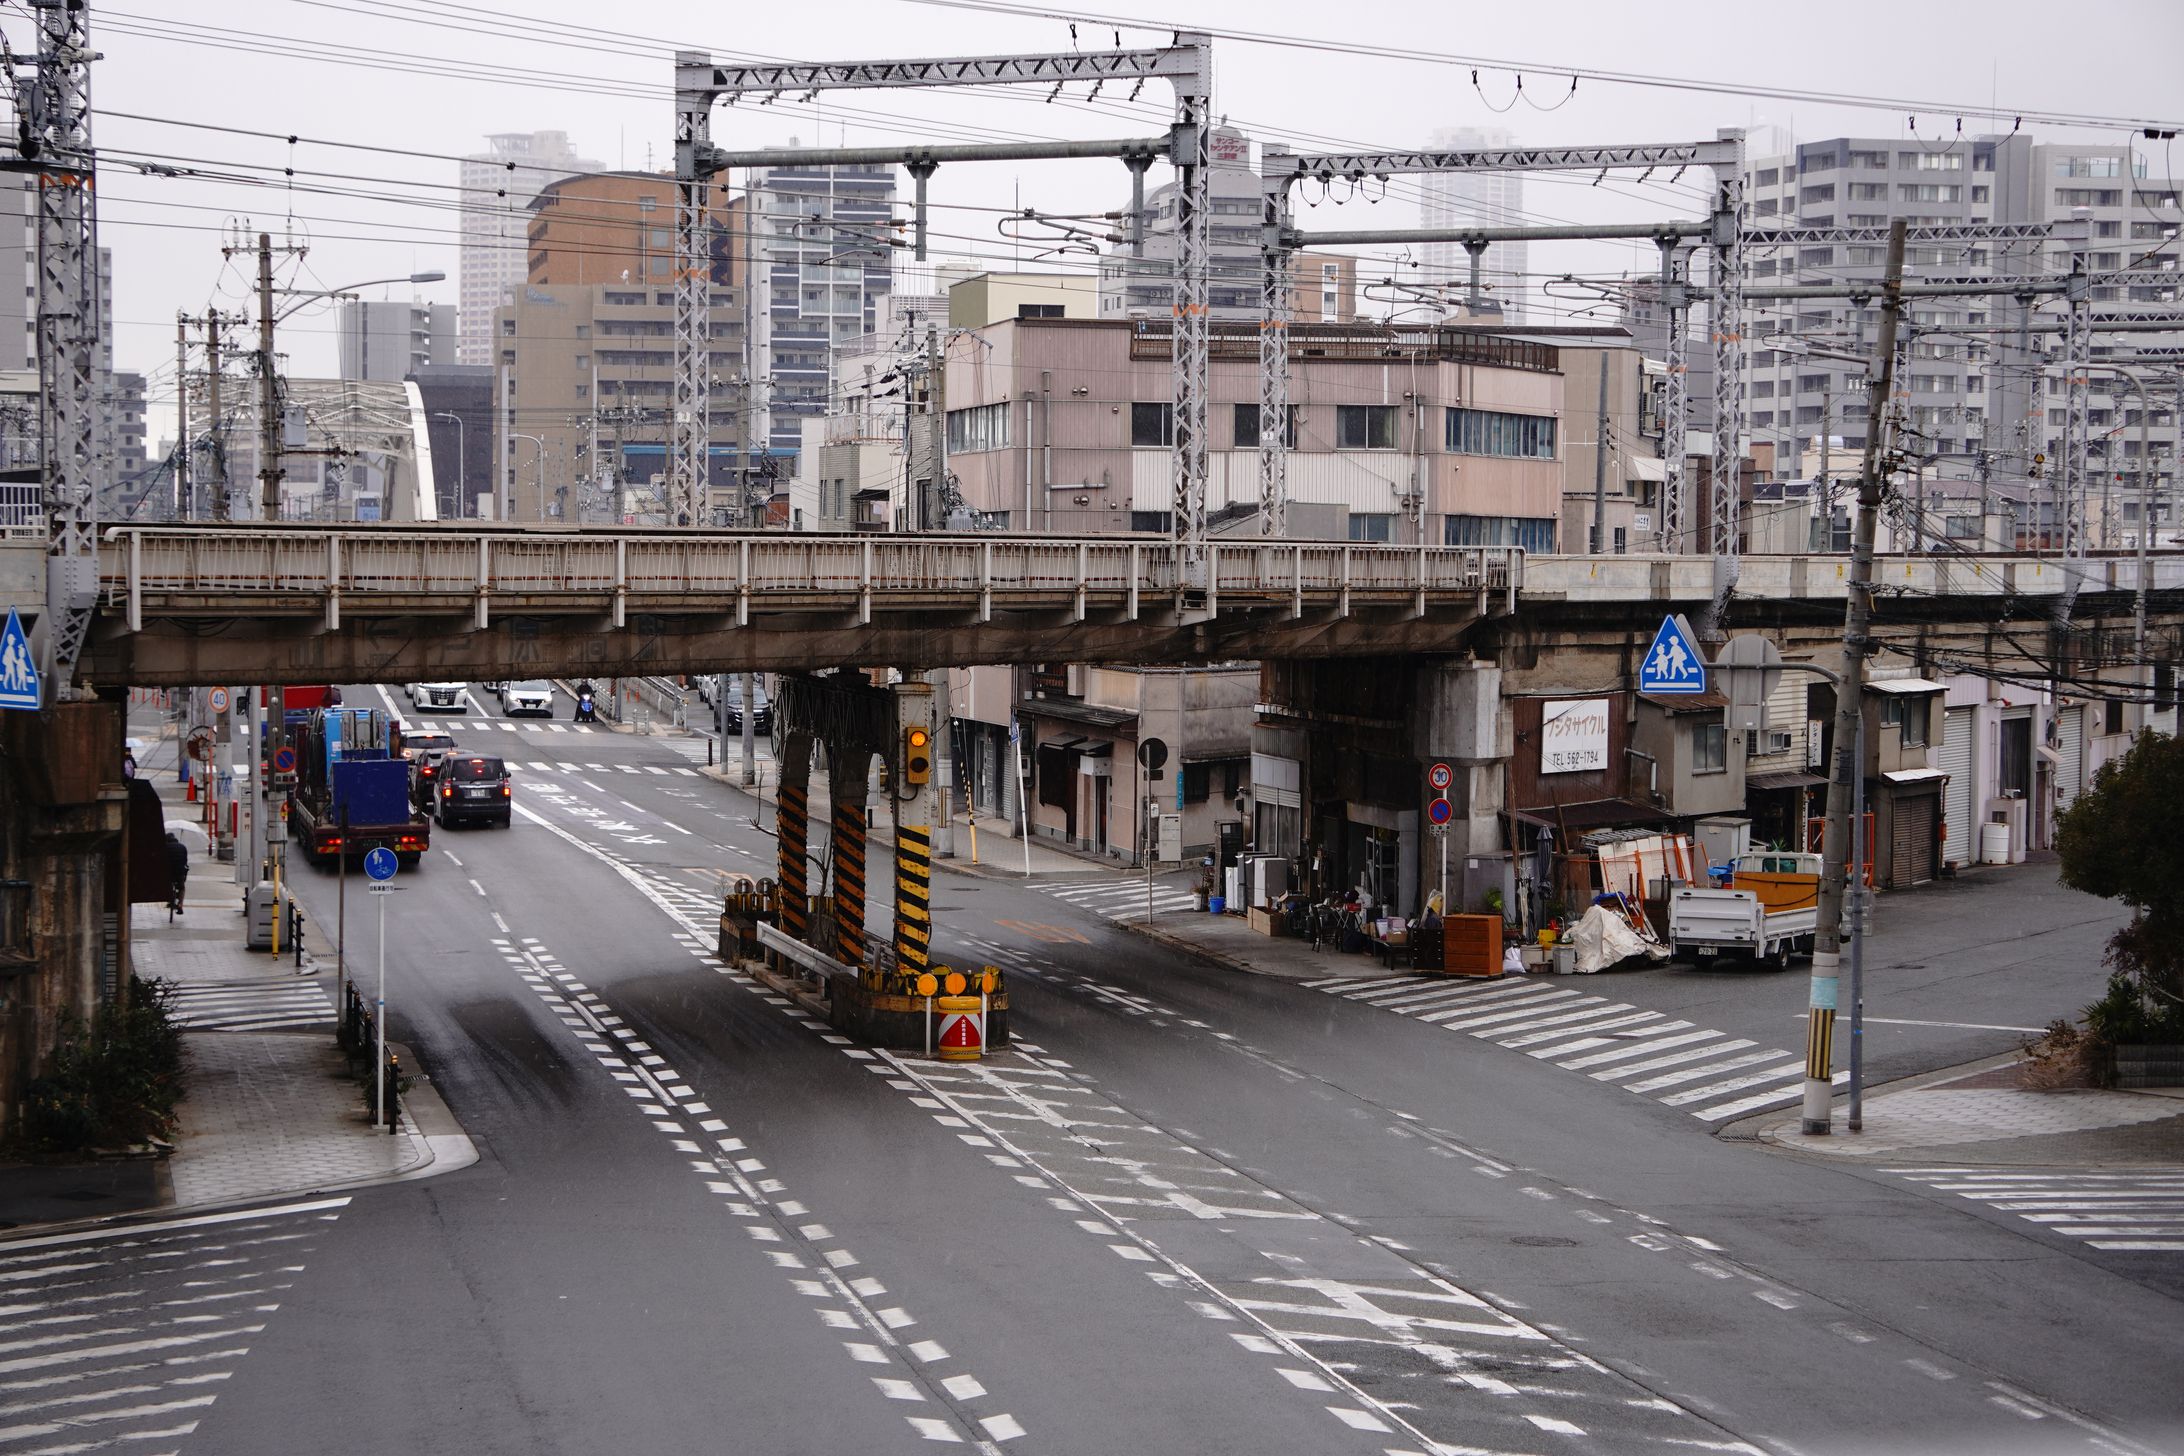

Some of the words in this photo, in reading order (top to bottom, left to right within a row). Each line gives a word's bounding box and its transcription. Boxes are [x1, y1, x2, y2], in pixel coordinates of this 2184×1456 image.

[214, 693, 225, 705] 40
[1553, 753, 1564, 766] TEL
[1567, 751, 1599, 765] 562-1794
[1434, 771, 1448, 783] 30
